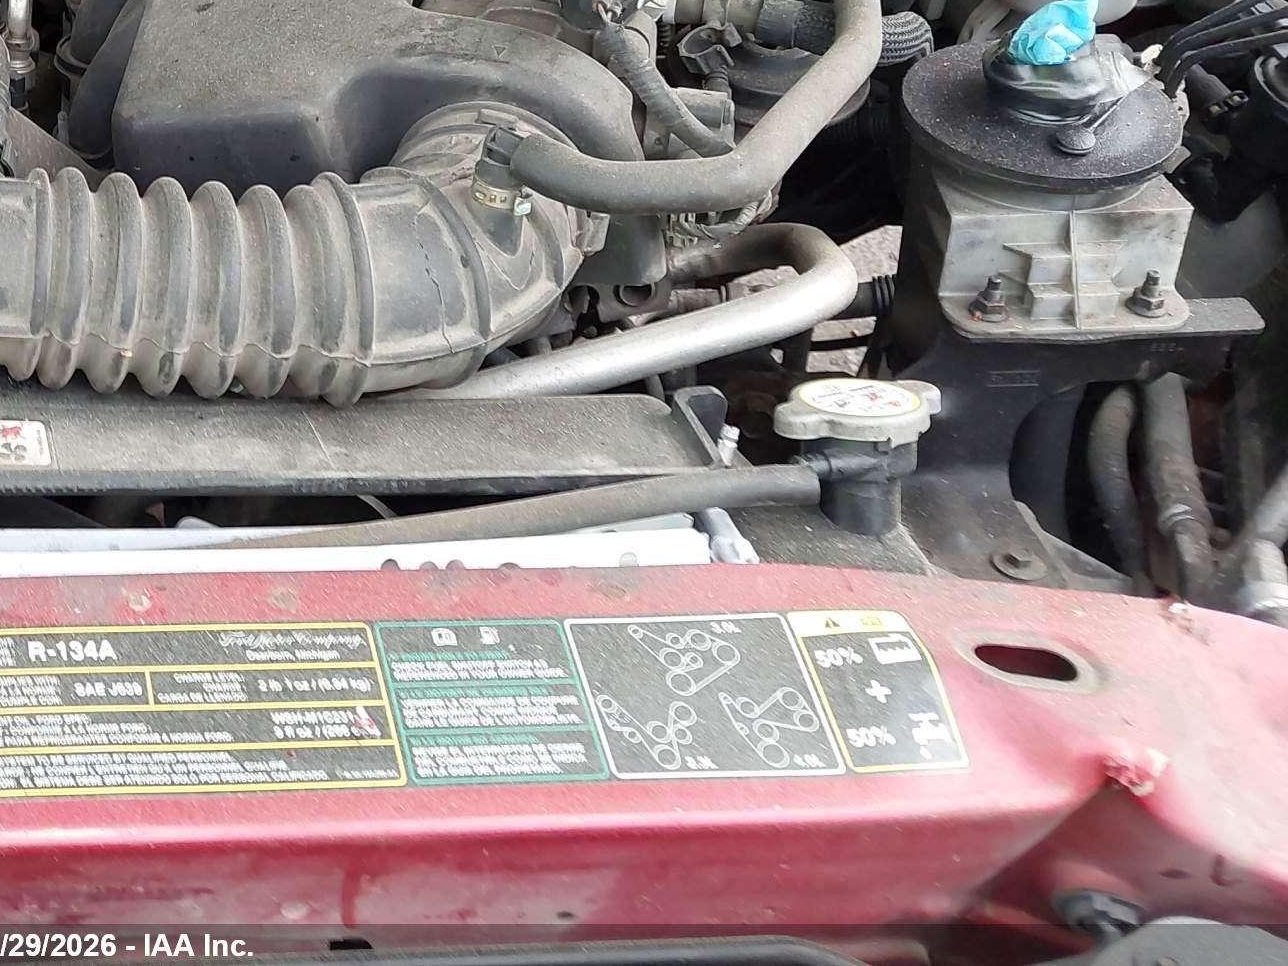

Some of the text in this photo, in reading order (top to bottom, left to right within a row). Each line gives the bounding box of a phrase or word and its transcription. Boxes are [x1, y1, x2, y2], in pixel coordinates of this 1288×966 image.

[711, 621, 742, 634] 3.0L
[26, 638, 118, 662] R-134A
[296, 648, 341, 660] Michigan
[815, 649, 864, 668] 50%
[74, 682, 106, 698] SAE
[847, 727, 897, 748] 50%
